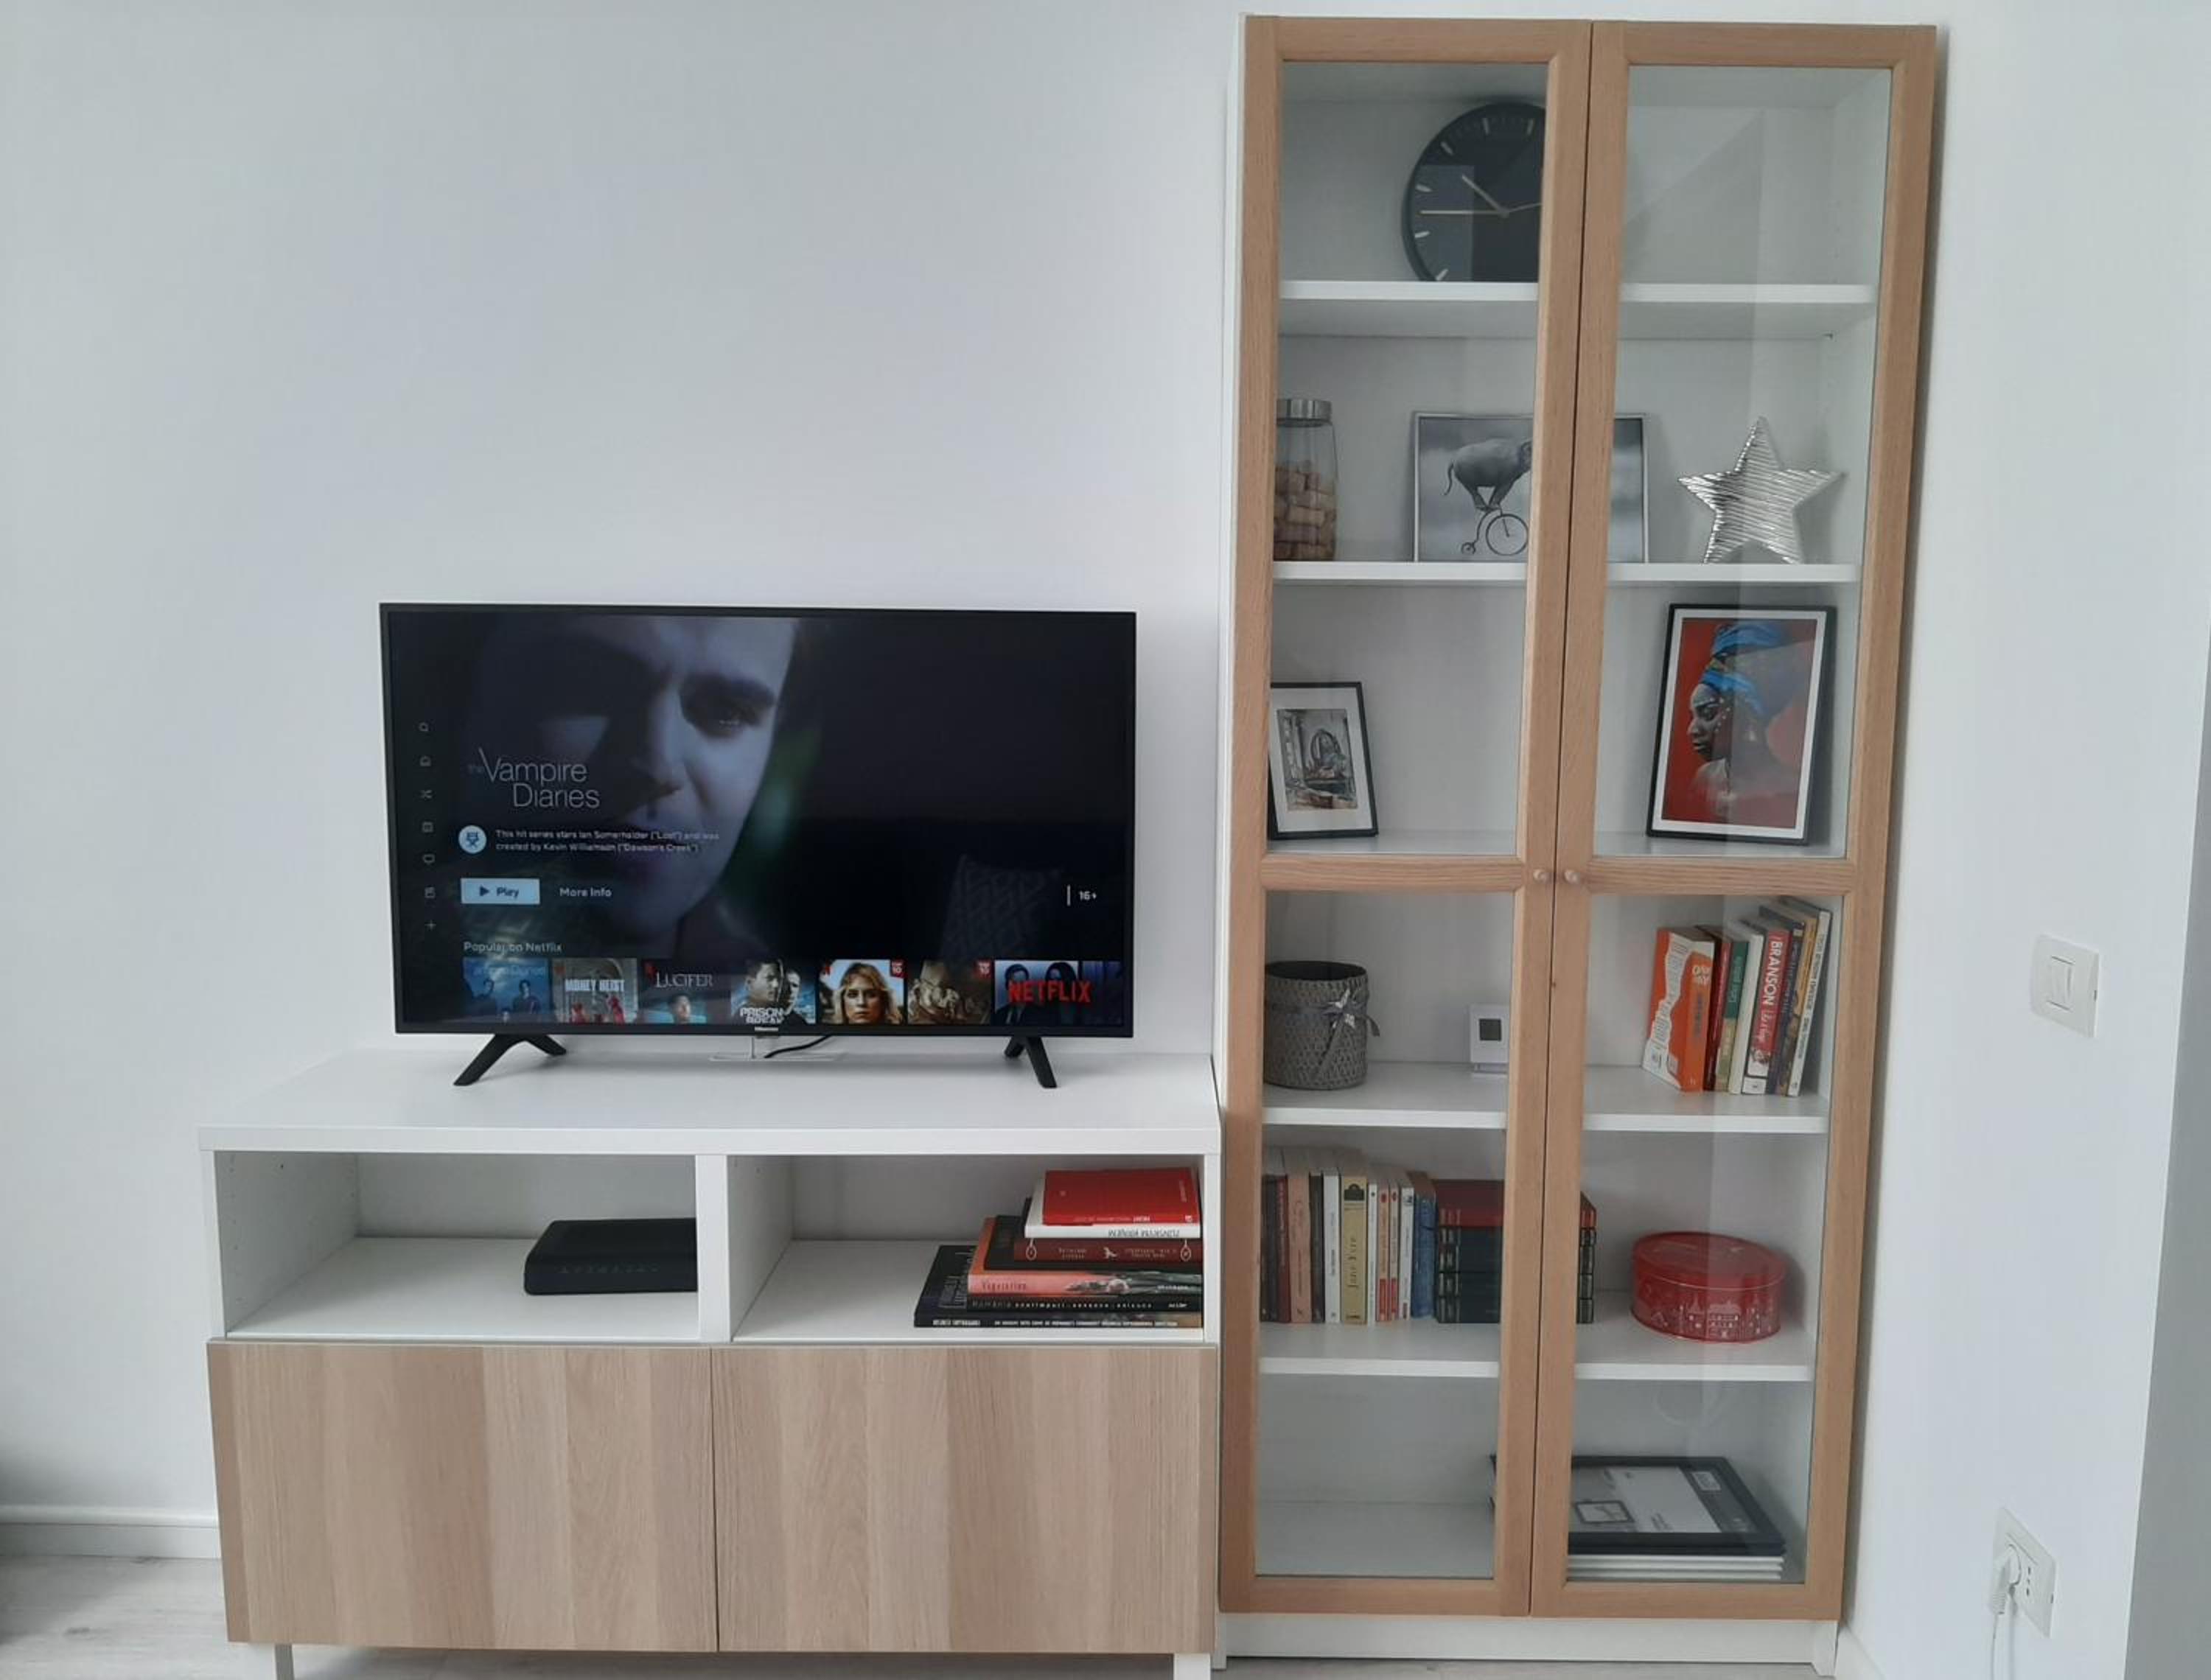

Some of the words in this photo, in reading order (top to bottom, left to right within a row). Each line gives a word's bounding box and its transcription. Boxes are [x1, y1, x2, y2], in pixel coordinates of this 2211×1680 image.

[479, 746, 587, 786] Vampire
[513, 783, 600, 808] Diaries
[495, 830, 514, 838] This
[496, 886, 520, 898] Play
[559, 887, 588, 897] More
[590, 886, 612, 897] Info
[464, 942, 506, 953] Popular
[509, 944, 523, 952] on
[525, 942, 562, 953] Netflix
[656, 972, 713, 988] LUCIFER
[1762, 941, 1784, 1006] BRANSON
[1007, 979, 1091, 1003] NETFLIX
[739, 1007, 784, 1017] PRISON
